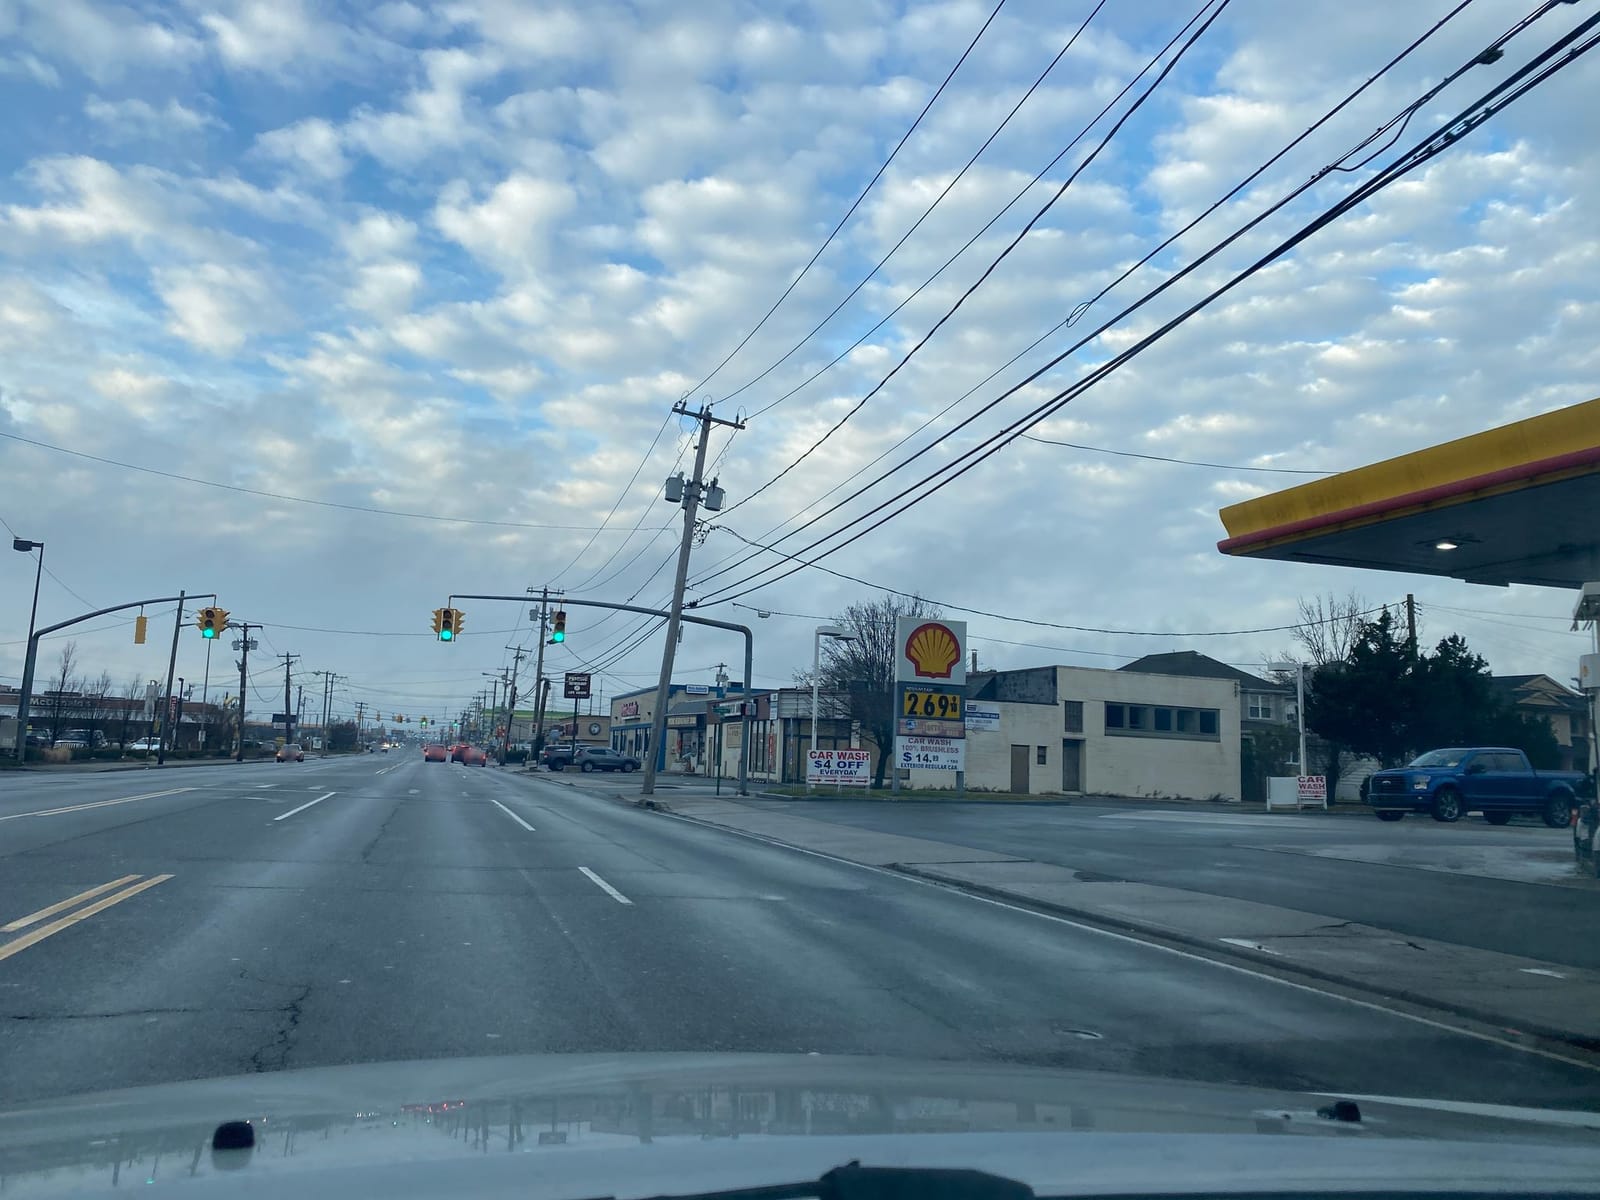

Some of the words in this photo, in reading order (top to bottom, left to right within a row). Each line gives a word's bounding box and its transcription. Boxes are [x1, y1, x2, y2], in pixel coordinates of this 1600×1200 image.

[908, 693, 949, 717] 2.69
[928, 738, 951, 746] WASH
[920, 745, 959, 753] BRUSHLESS
[809, 751, 833, 760] CAR
[837, 751, 869, 760] WASH
[814, 760, 831, 769] $4
[837, 761, 864, 769] OFF
